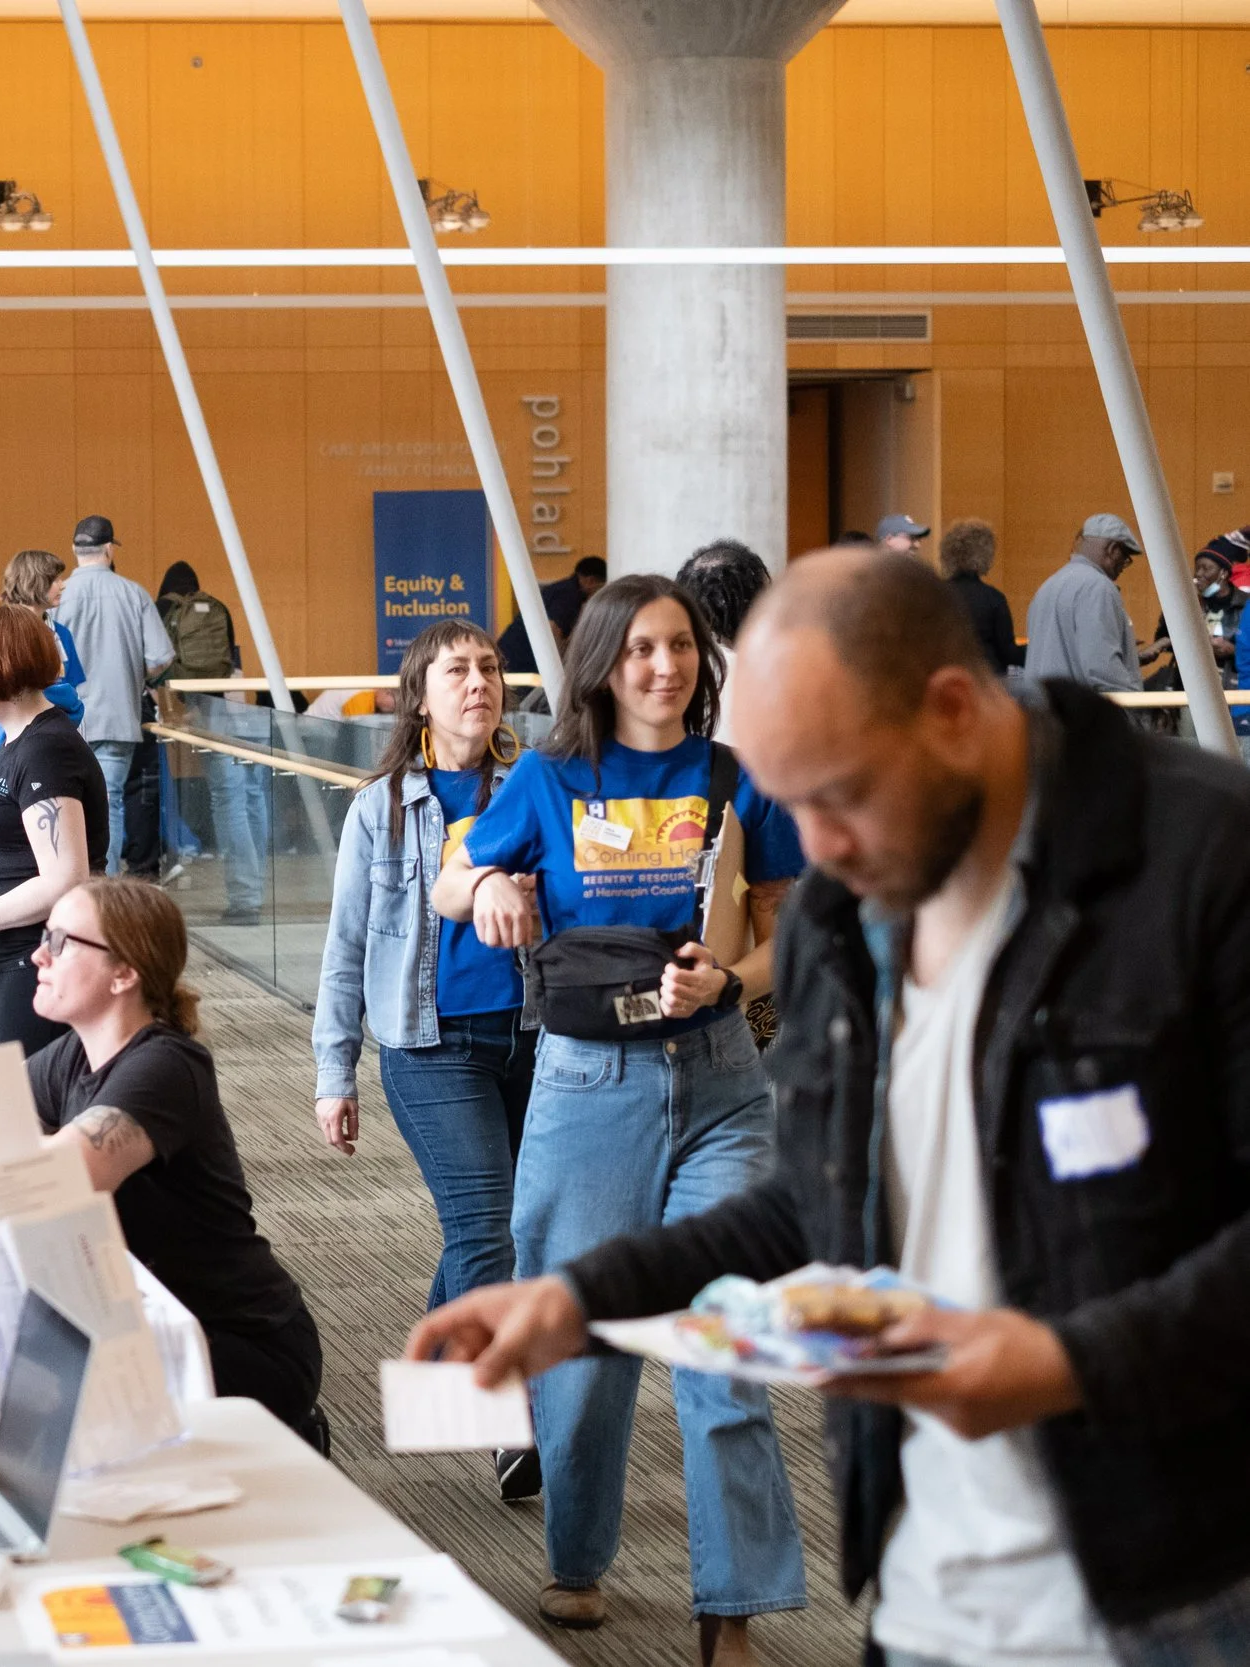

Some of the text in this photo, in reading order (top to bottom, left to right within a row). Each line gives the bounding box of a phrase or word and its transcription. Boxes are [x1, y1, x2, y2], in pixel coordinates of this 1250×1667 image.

[521, 394, 573, 554] pohlad
[384, 573, 465, 596] Equity &
[384, 598, 470, 617] Inclusion
[583, 844, 698, 867] Coming Ho
[582, 874, 634, 885] REENTRY
[582, 886, 594, 898] at
[595, 885, 648, 898] Hennepin
